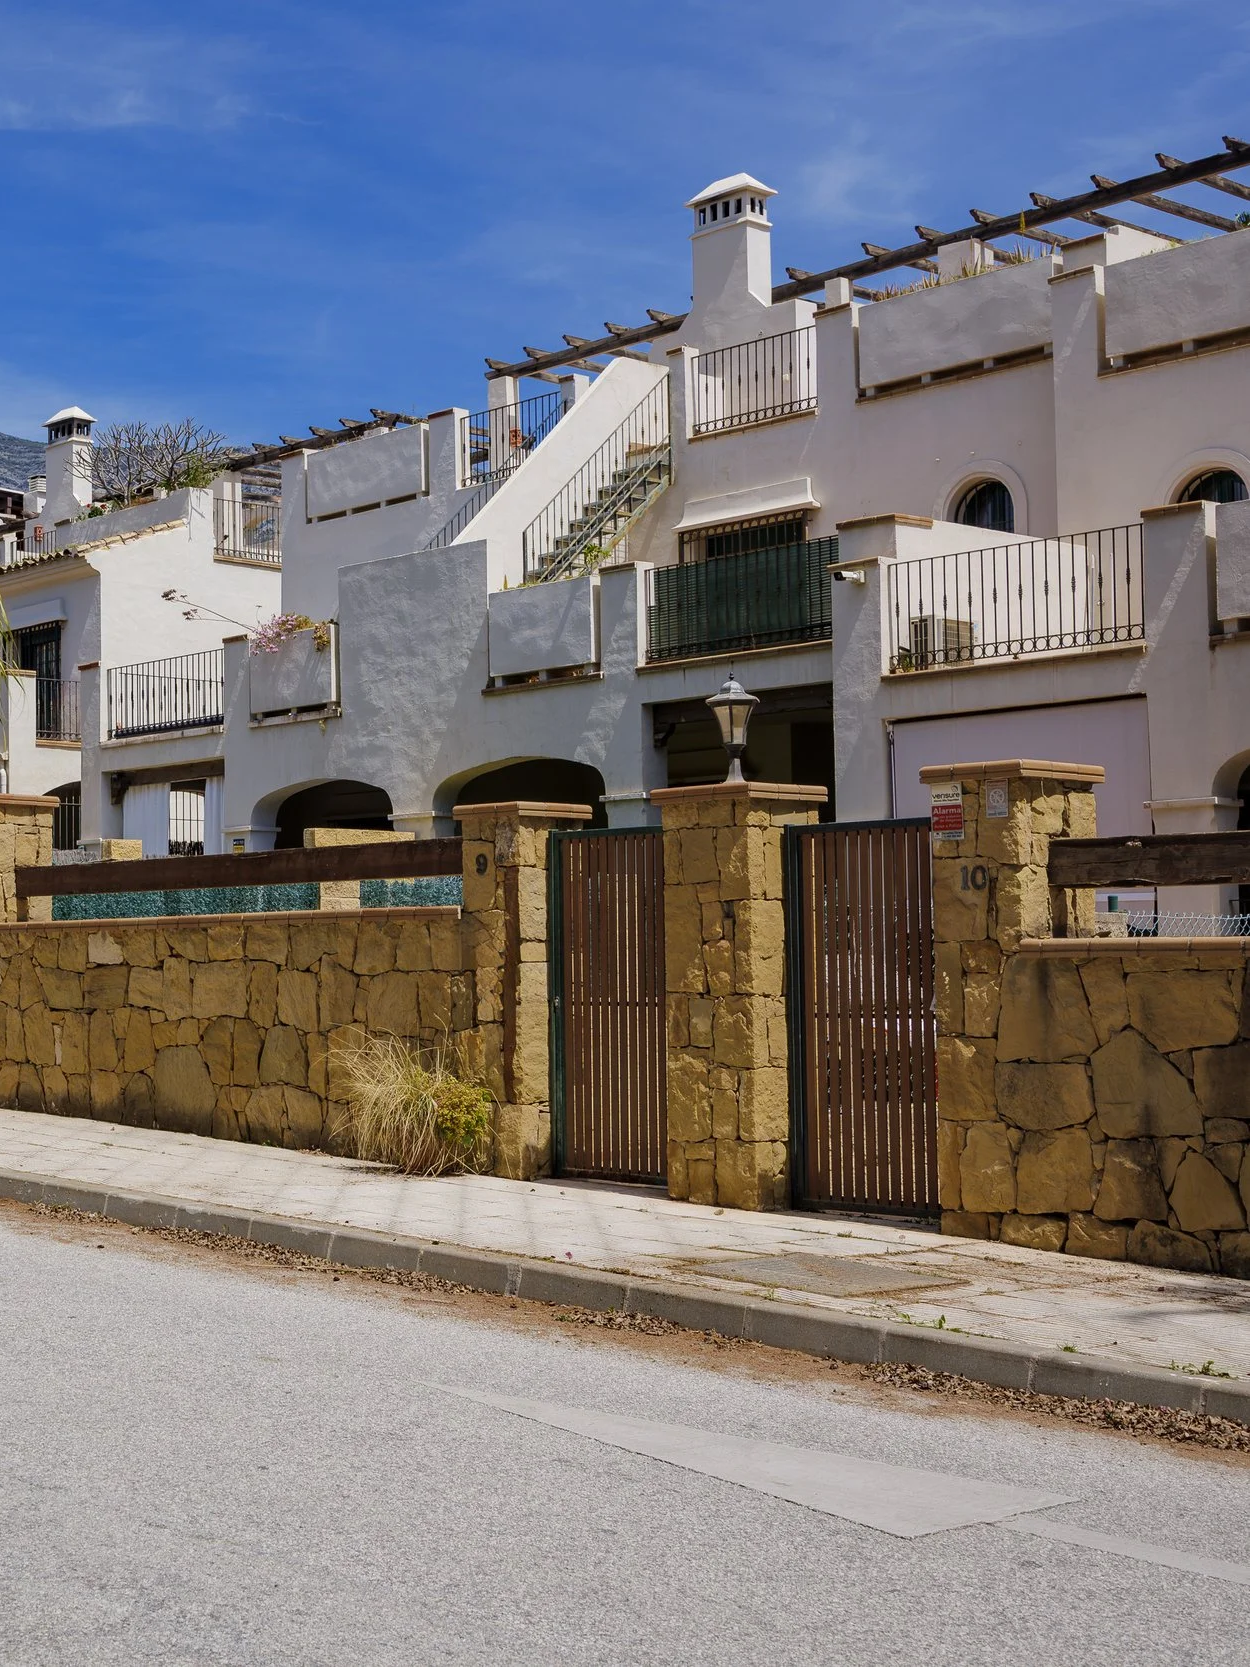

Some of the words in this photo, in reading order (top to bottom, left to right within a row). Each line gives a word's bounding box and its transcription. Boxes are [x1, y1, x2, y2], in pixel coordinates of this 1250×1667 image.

[933, 806, 961, 815] Alarma
[476, 854, 487, 875] 9
[961, 864, 987, 891] 10
